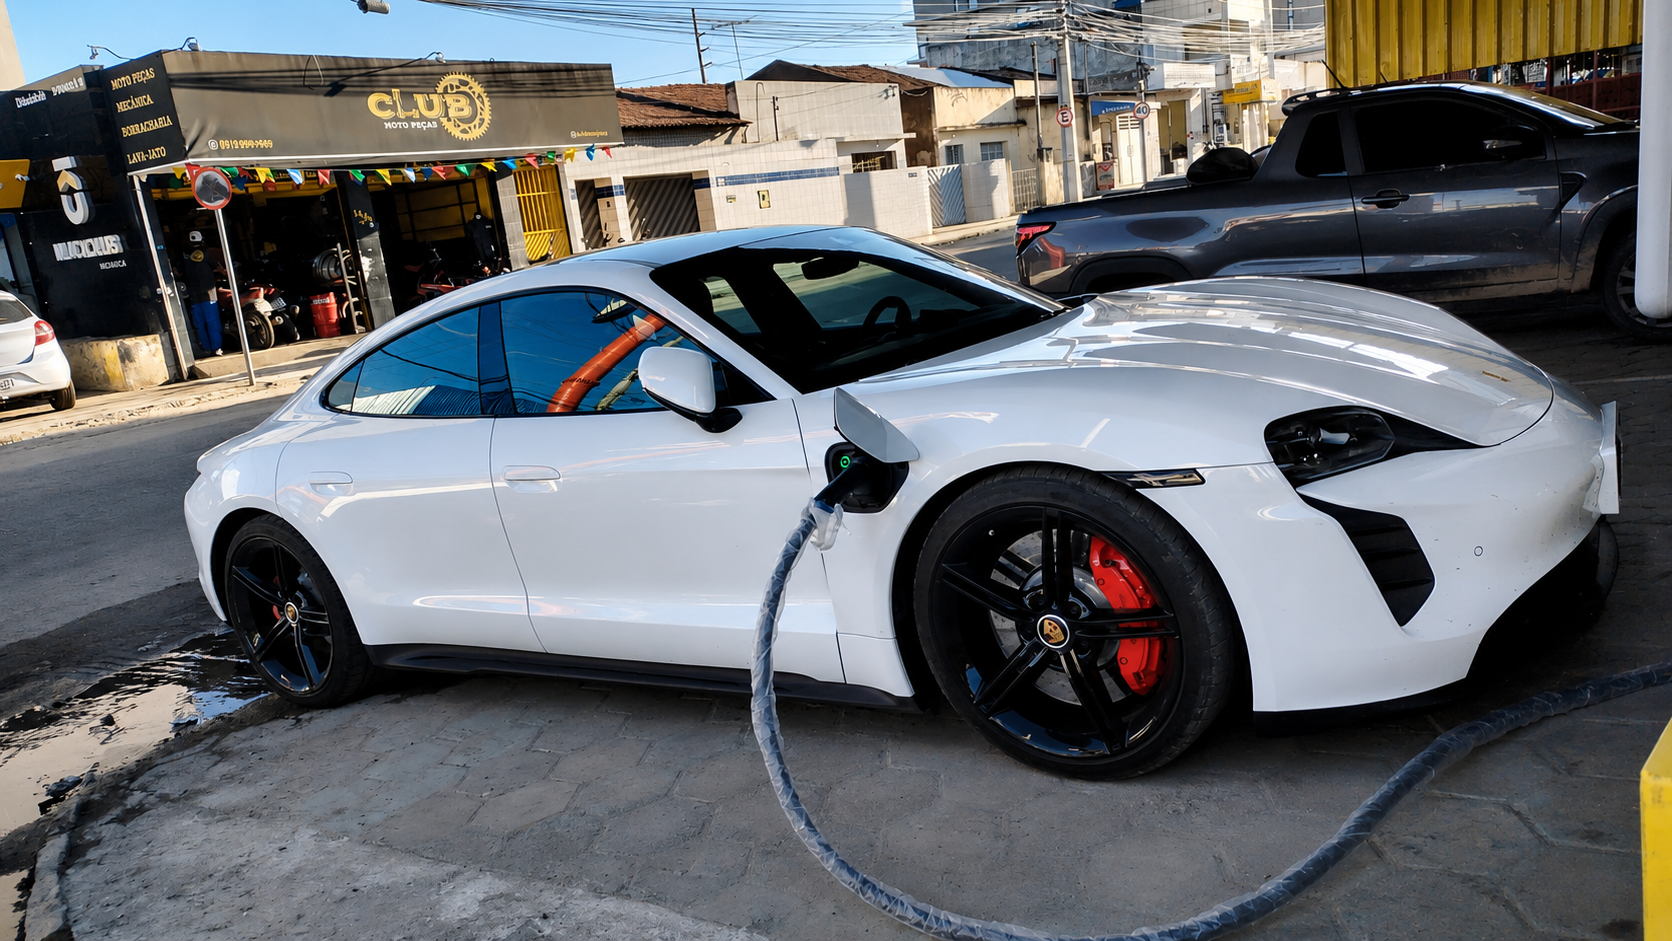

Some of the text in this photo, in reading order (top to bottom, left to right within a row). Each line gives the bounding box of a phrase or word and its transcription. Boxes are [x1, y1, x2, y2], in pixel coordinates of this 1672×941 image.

[110, 67, 155, 90] MOTO PEÇAS
[367, 88, 472, 119] CLUB
[1136, 105, 1148, 114] 40
[1060, 111, 1069, 122] E
[384, 121, 438, 130] MOTO PEÇAS
